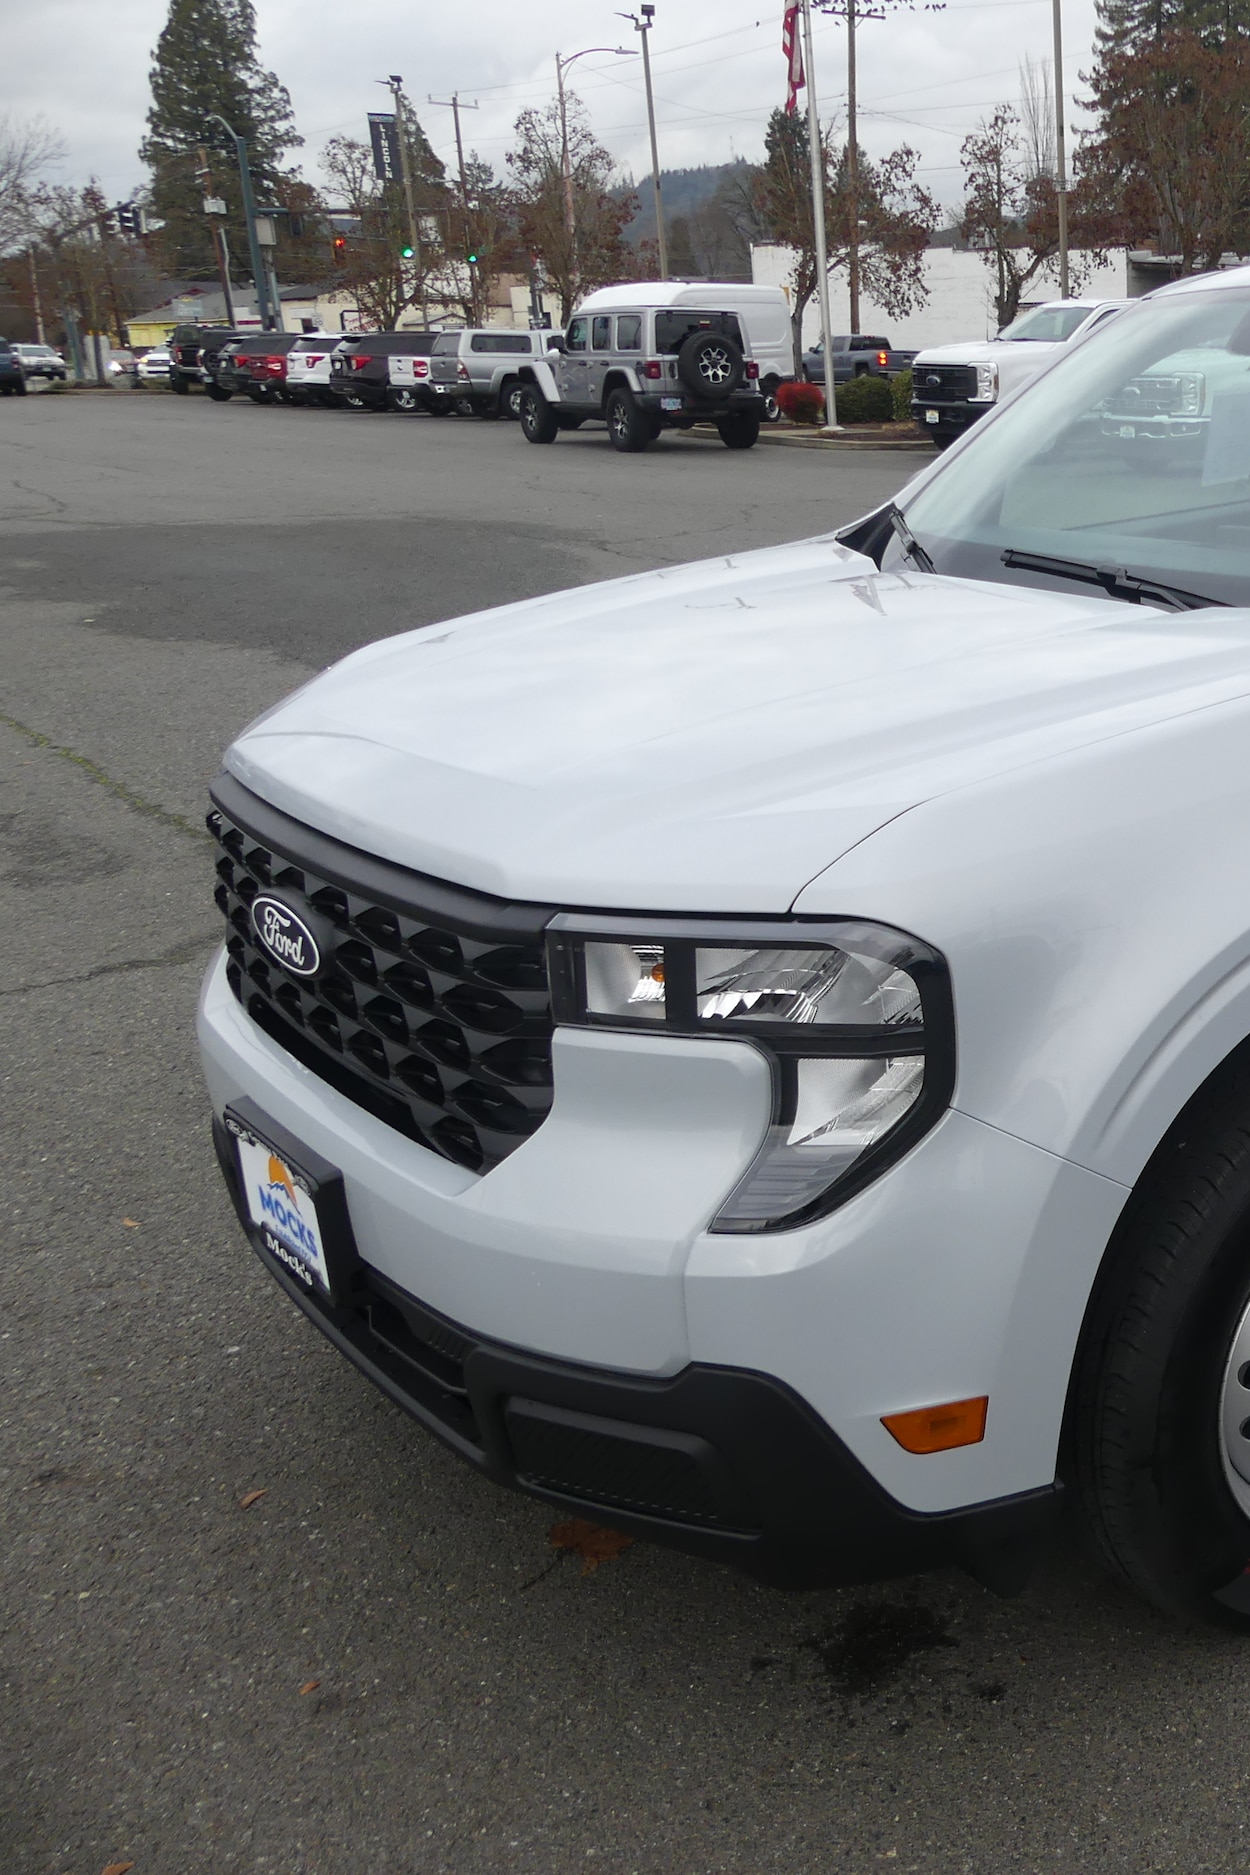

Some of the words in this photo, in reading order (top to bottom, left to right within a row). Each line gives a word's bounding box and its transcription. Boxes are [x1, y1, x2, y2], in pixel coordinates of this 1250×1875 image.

[379, 124, 393, 179] LINCOLN
[263, 905, 305, 967] Ford
[258, 1184, 319, 1259] MOCKS
